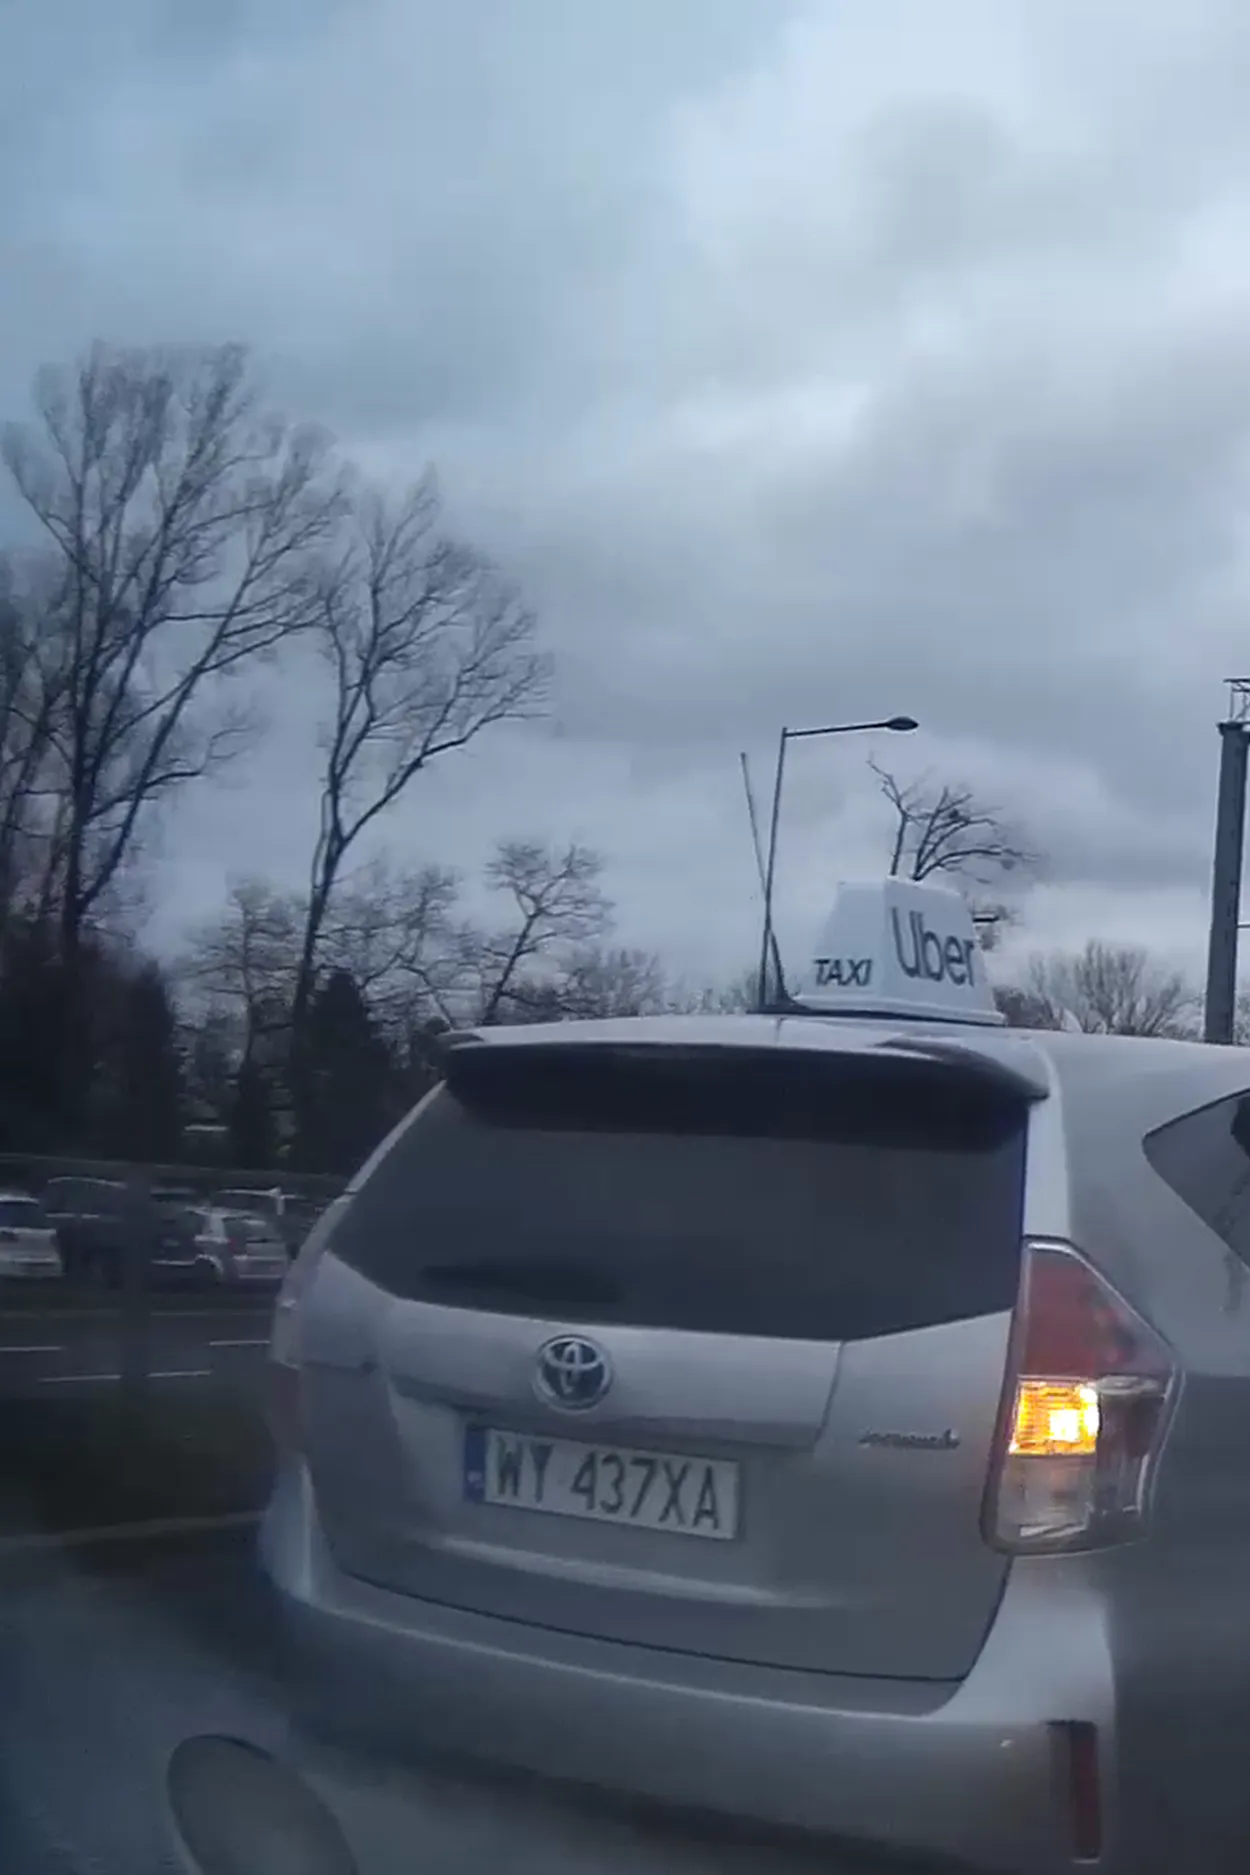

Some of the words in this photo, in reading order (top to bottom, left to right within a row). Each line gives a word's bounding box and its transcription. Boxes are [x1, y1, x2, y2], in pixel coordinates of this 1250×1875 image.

[814, 958, 874, 987] TAXI
[891, 906, 975, 988] Uber
[496, 1435, 556, 1501] WY
[569, 1452, 720, 1530] 437XA
